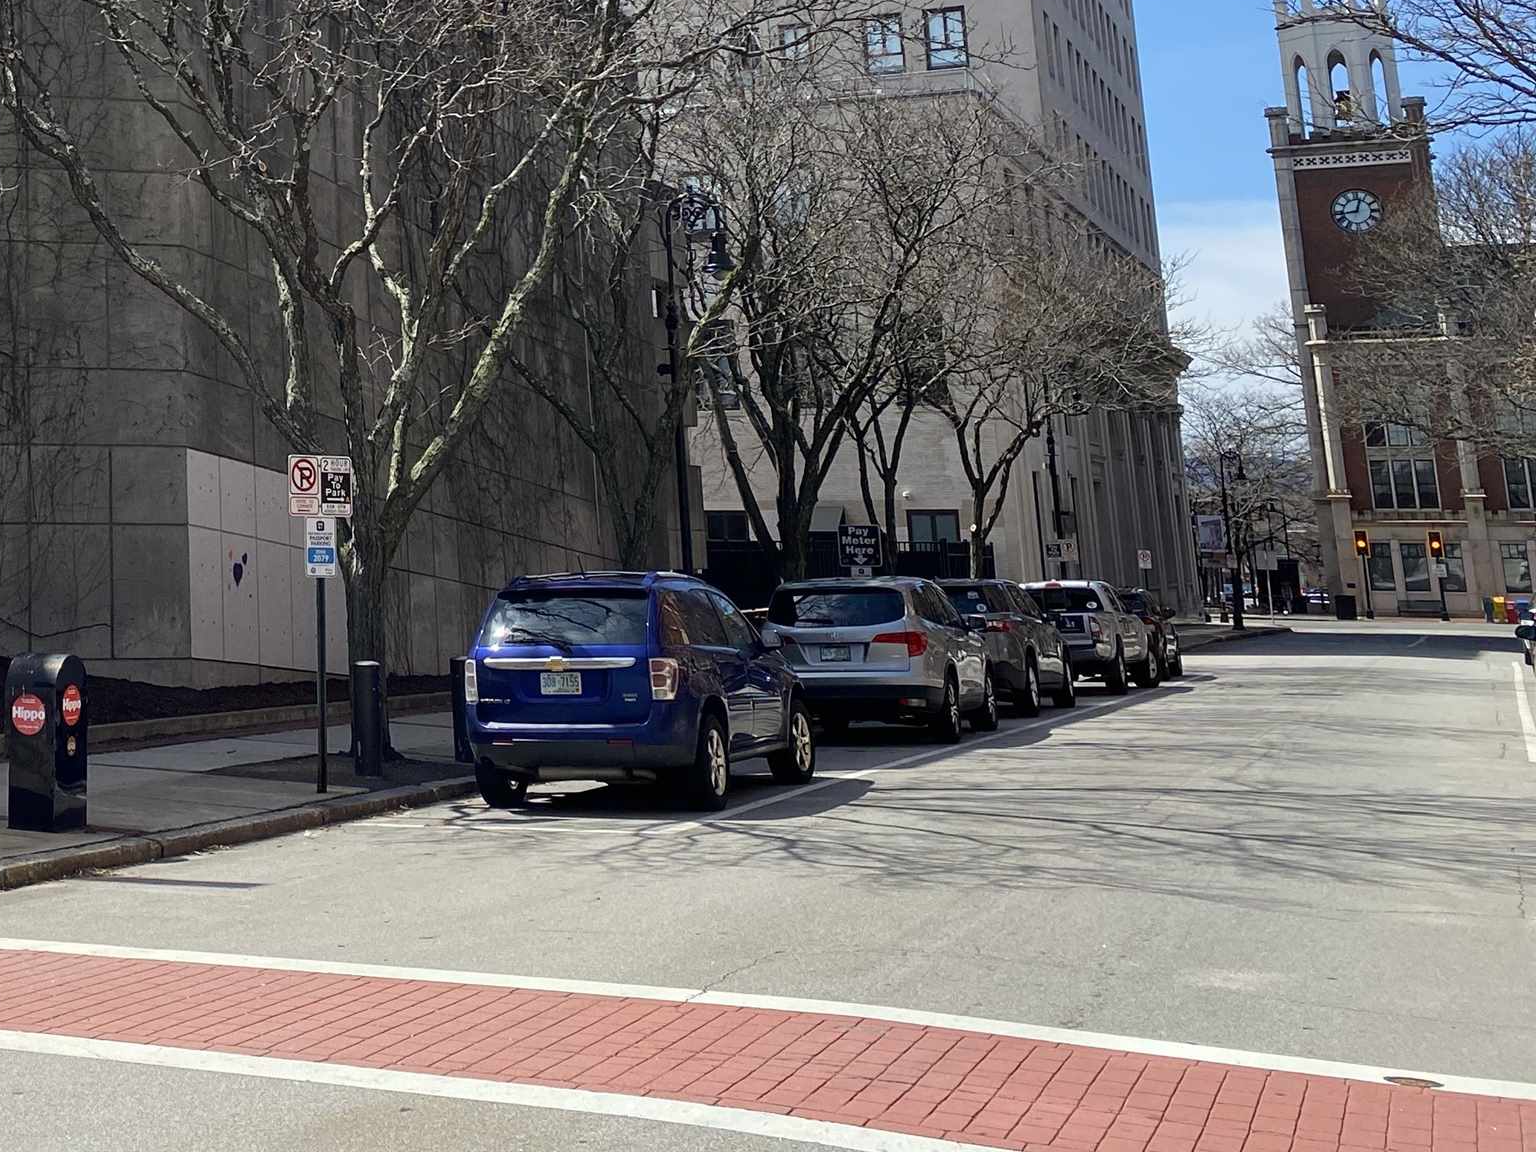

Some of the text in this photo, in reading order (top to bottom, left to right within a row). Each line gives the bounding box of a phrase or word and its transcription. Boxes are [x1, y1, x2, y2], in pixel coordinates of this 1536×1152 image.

[323, 459, 329, 471] 2
[327, 473, 344, 483] Pay
[330, 481, 342, 489] To
[325, 488, 346, 497] Park
[847, 526, 869, 536] Pay
[841, 536, 876, 545] Meter
[845, 545, 874, 555] Here
[62, 697, 82, 713] Hippo
[11, 705, 46, 721] Hippo
